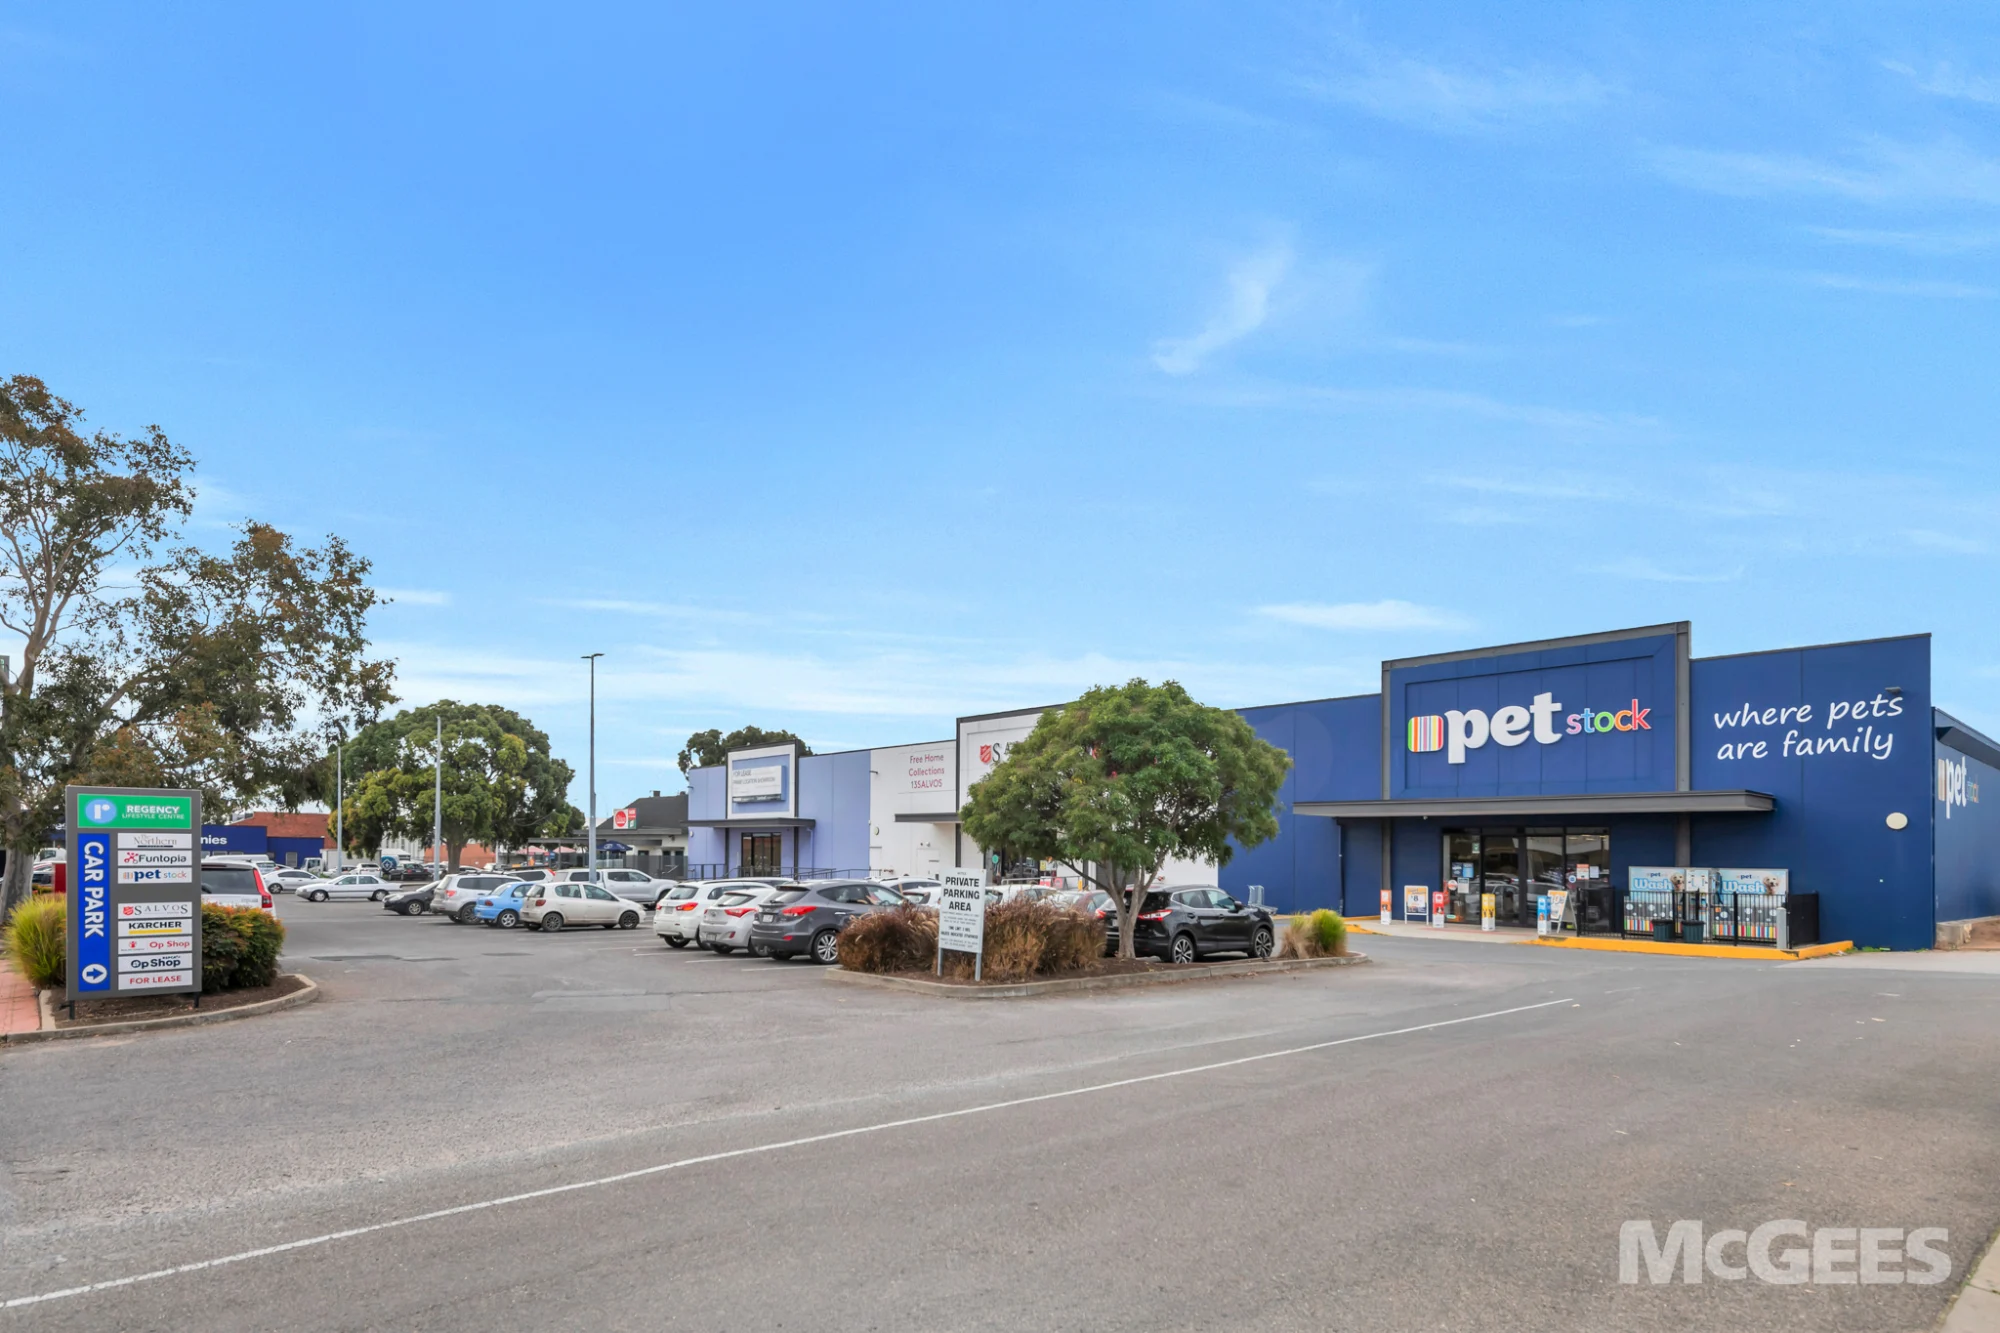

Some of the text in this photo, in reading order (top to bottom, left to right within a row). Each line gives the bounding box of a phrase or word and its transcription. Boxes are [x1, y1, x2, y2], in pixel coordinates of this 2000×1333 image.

[1713, 693, 1903, 729] where pets
[1444, 692, 1651, 764] pet stock
[1717, 725, 1893, 760] are family
[910, 754, 944, 764] Free Home
[908, 767, 945, 777] Collections
[911, 779, 943, 789] 13SALVOS
[1945, 756, 1967, 819] pet
[126, 805, 180, 814] REGENCY
[133, 836, 177, 845] Northern
[138, 854, 187, 864] Funtopia
[134, 869, 187, 881] pet stock
[945, 876, 980, 887] PRIVATE
[1634, 878, 1673, 890] Wash
[1723, 881, 1765, 893] Wash
[84, 841, 104, 938] CAR PARK
[943, 888, 980, 899] PARKING
[134, 904, 188, 916] SALVOS
[948, 901, 972, 911] AREA
[149, 940, 190, 949] Op Shop
[130, 958, 181, 969] Op Shop
[152, 975, 181, 983] LEASE
